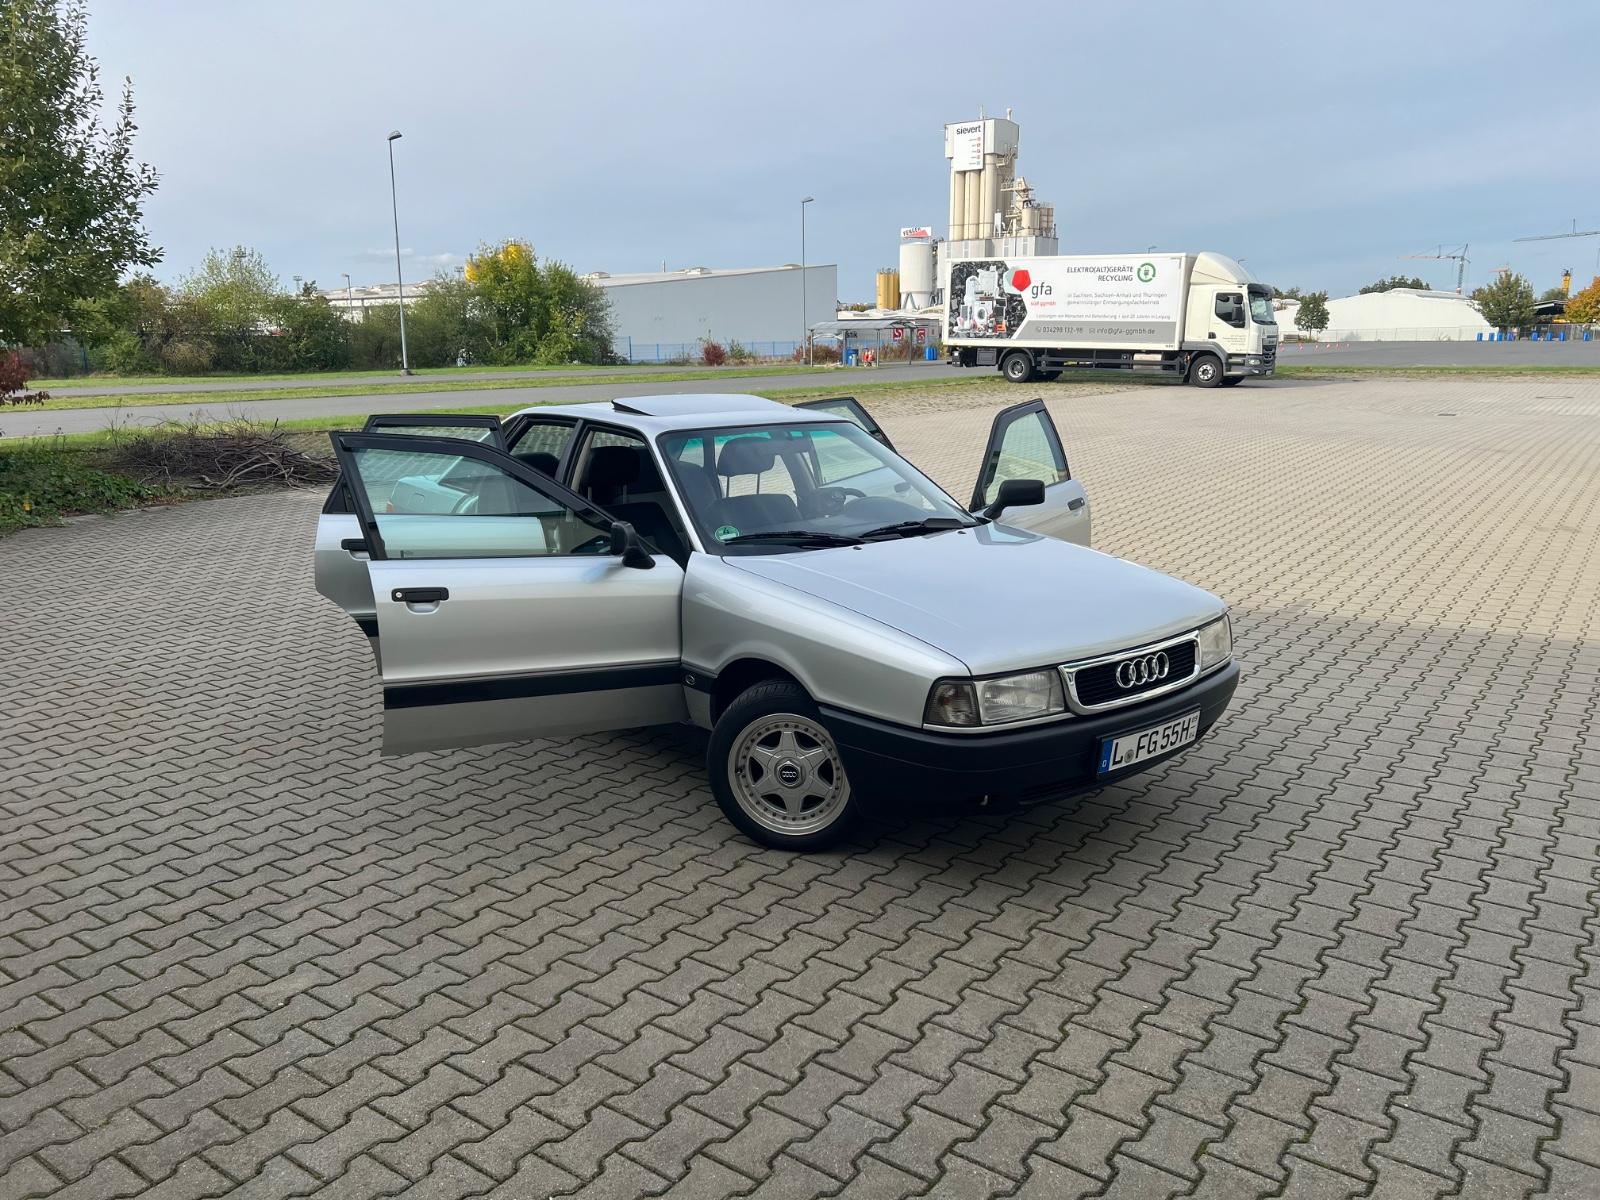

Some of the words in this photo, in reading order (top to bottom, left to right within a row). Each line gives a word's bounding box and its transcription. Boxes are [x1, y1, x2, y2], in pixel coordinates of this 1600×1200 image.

[956, 125, 981, 135] sievert
[1097, 274, 1133, 282] RECYCLING
[1031, 282, 1053, 299] gfa
[1112, 741, 1124, 766] L
[1135, 730, 1159, 759] FG
[1160, 717, 1191, 750] 55H
